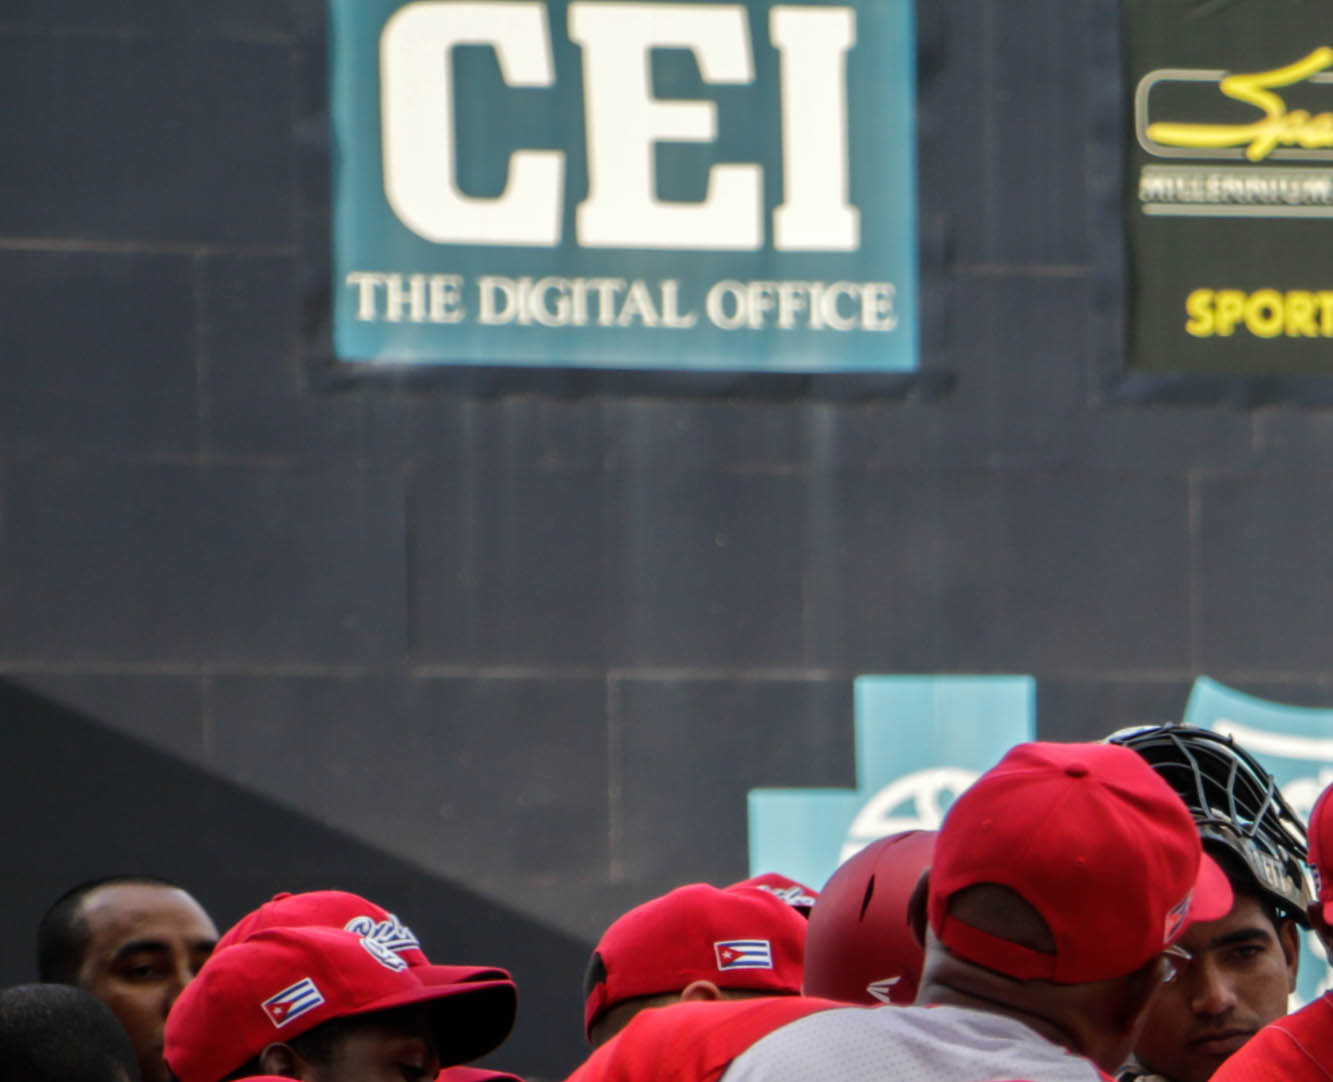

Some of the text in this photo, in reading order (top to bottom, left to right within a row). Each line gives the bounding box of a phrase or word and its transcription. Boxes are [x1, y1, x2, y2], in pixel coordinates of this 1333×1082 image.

[379, 0, 862, 252] CEI
[347, 271, 898, 332] THE DIGITAL OFFICE
